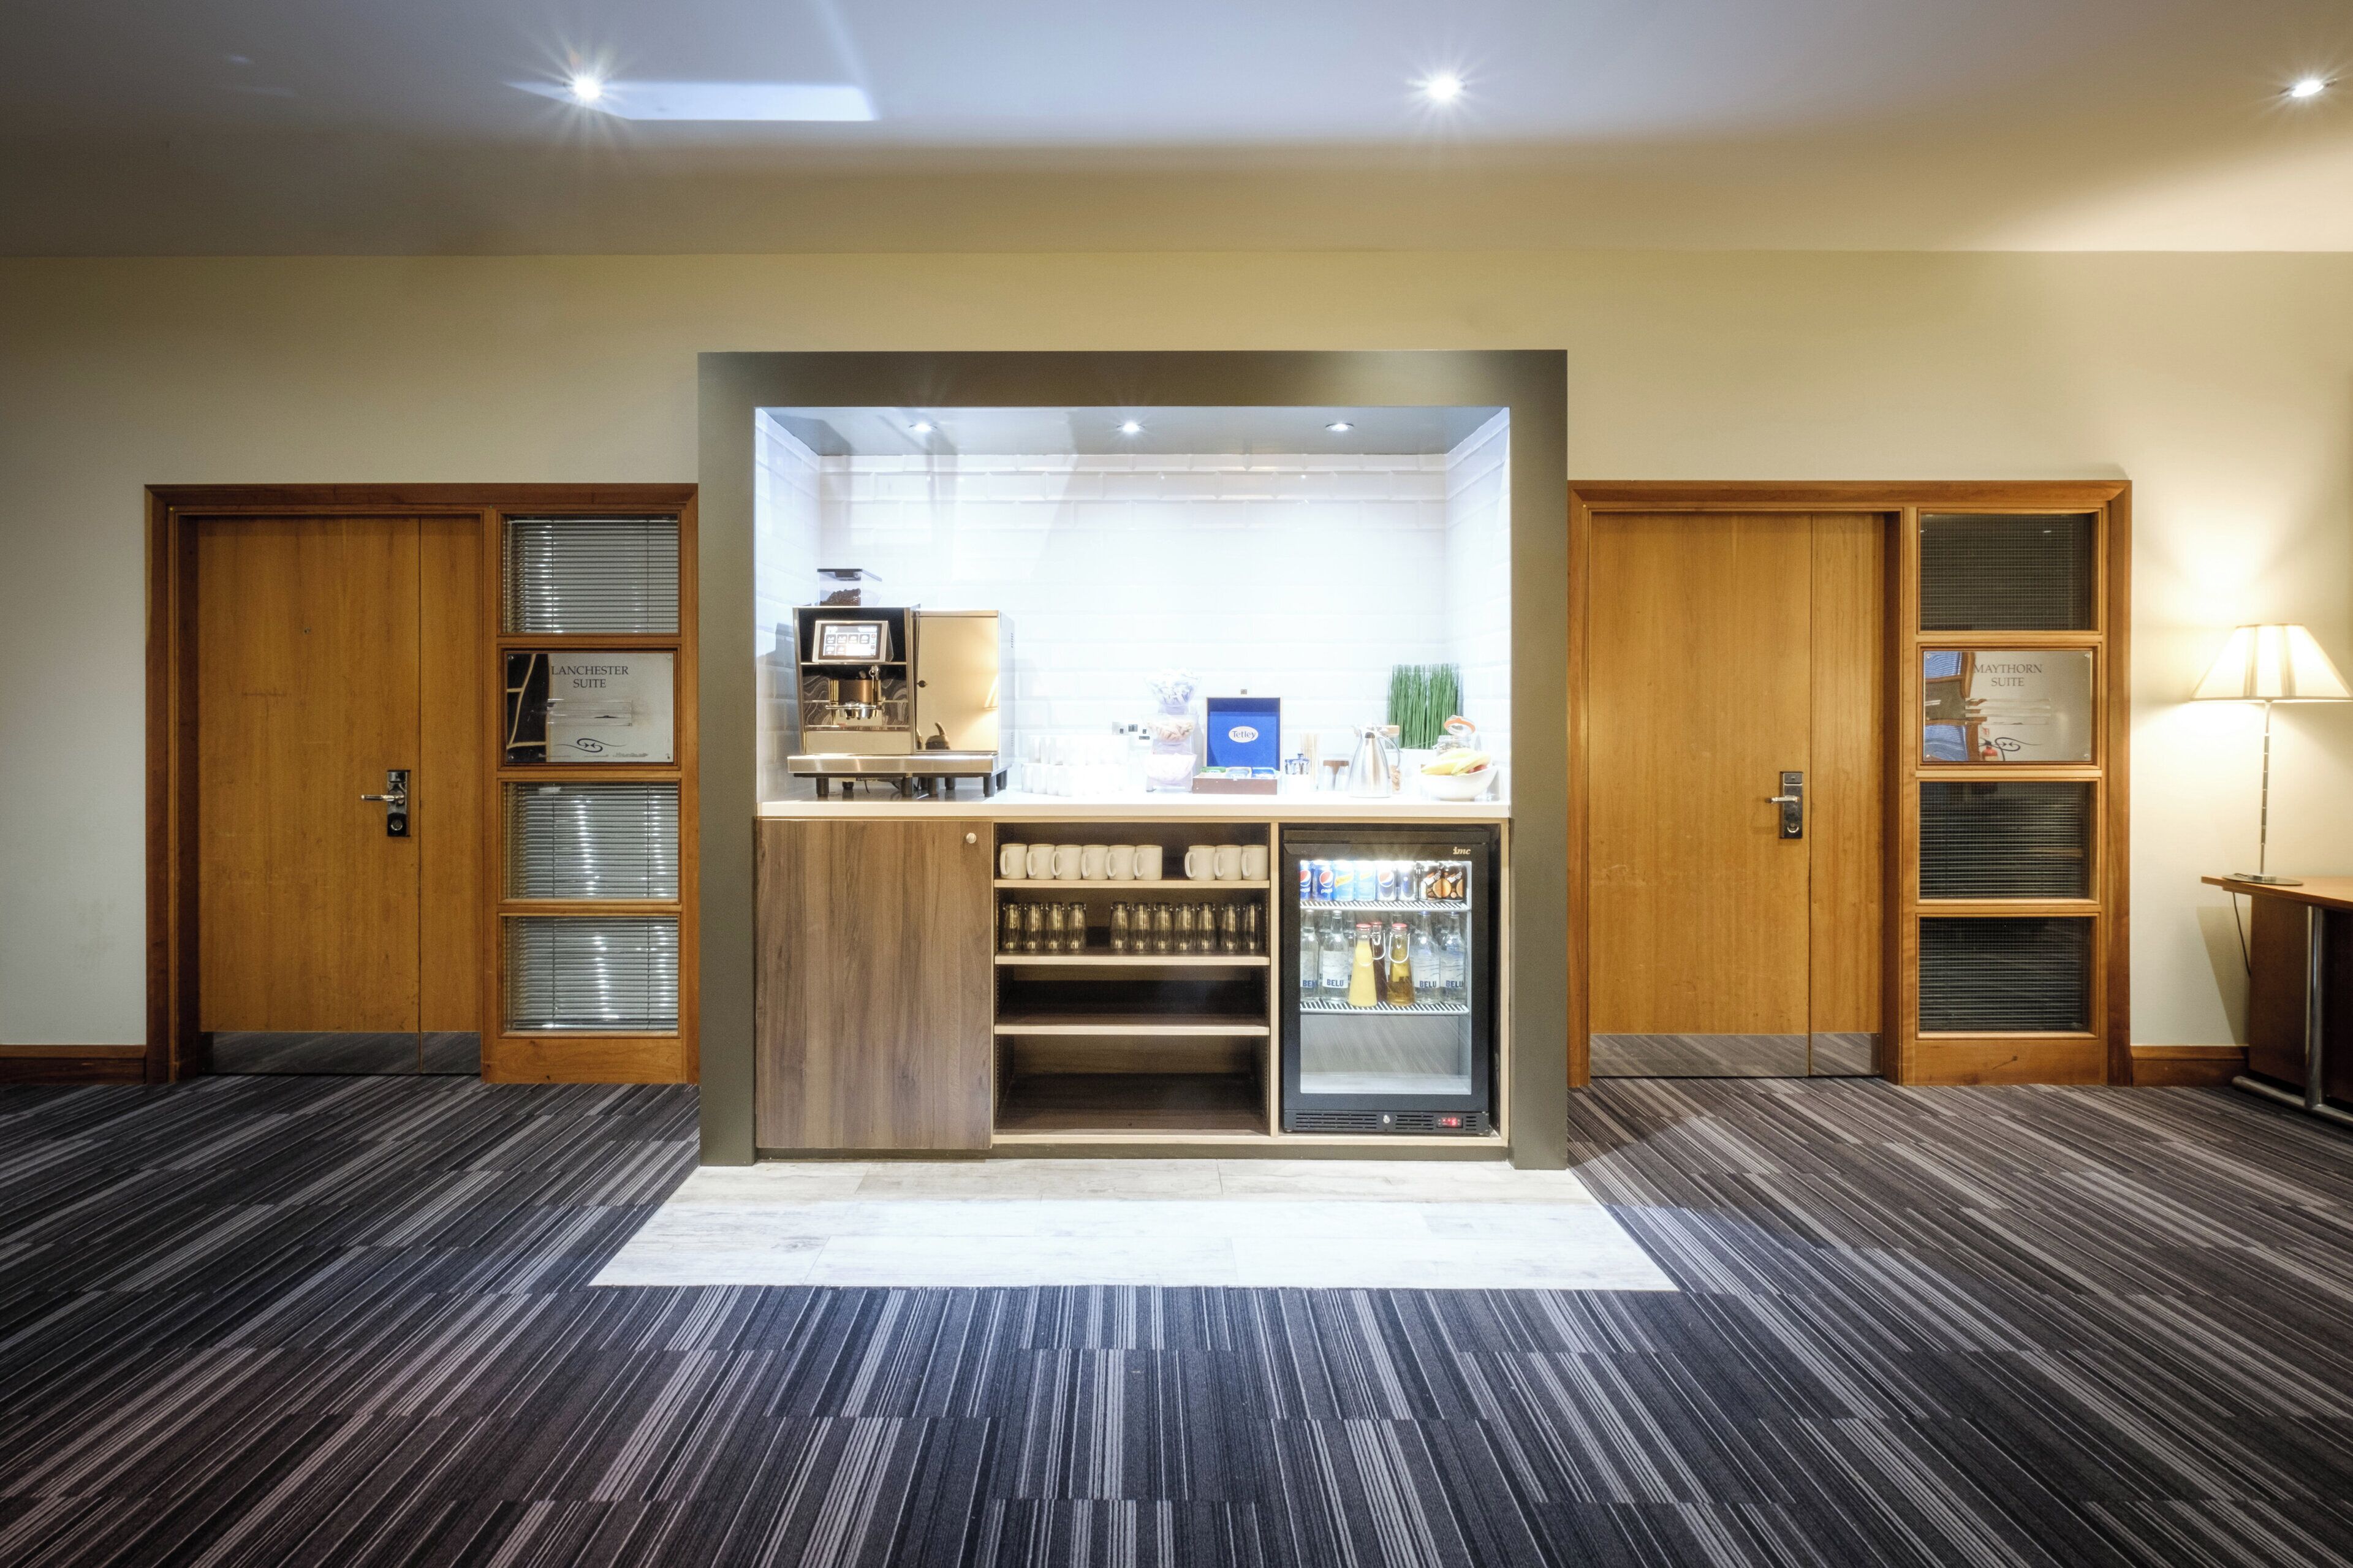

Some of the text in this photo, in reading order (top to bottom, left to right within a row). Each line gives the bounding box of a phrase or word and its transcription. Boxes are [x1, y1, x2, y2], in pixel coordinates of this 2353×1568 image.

[551, 665, 629, 675] LANCHESTER
[1974, 664, 2042, 673] MAYTHORN
[573, 678, 607, 688] SUITE
[1991, 677, 2025, 687] SUITE
[1232, 730, 1256, 740] Tetley
[1452, 846, 1471, 855] imc
[1327, 979, 1344, 987] BELU
